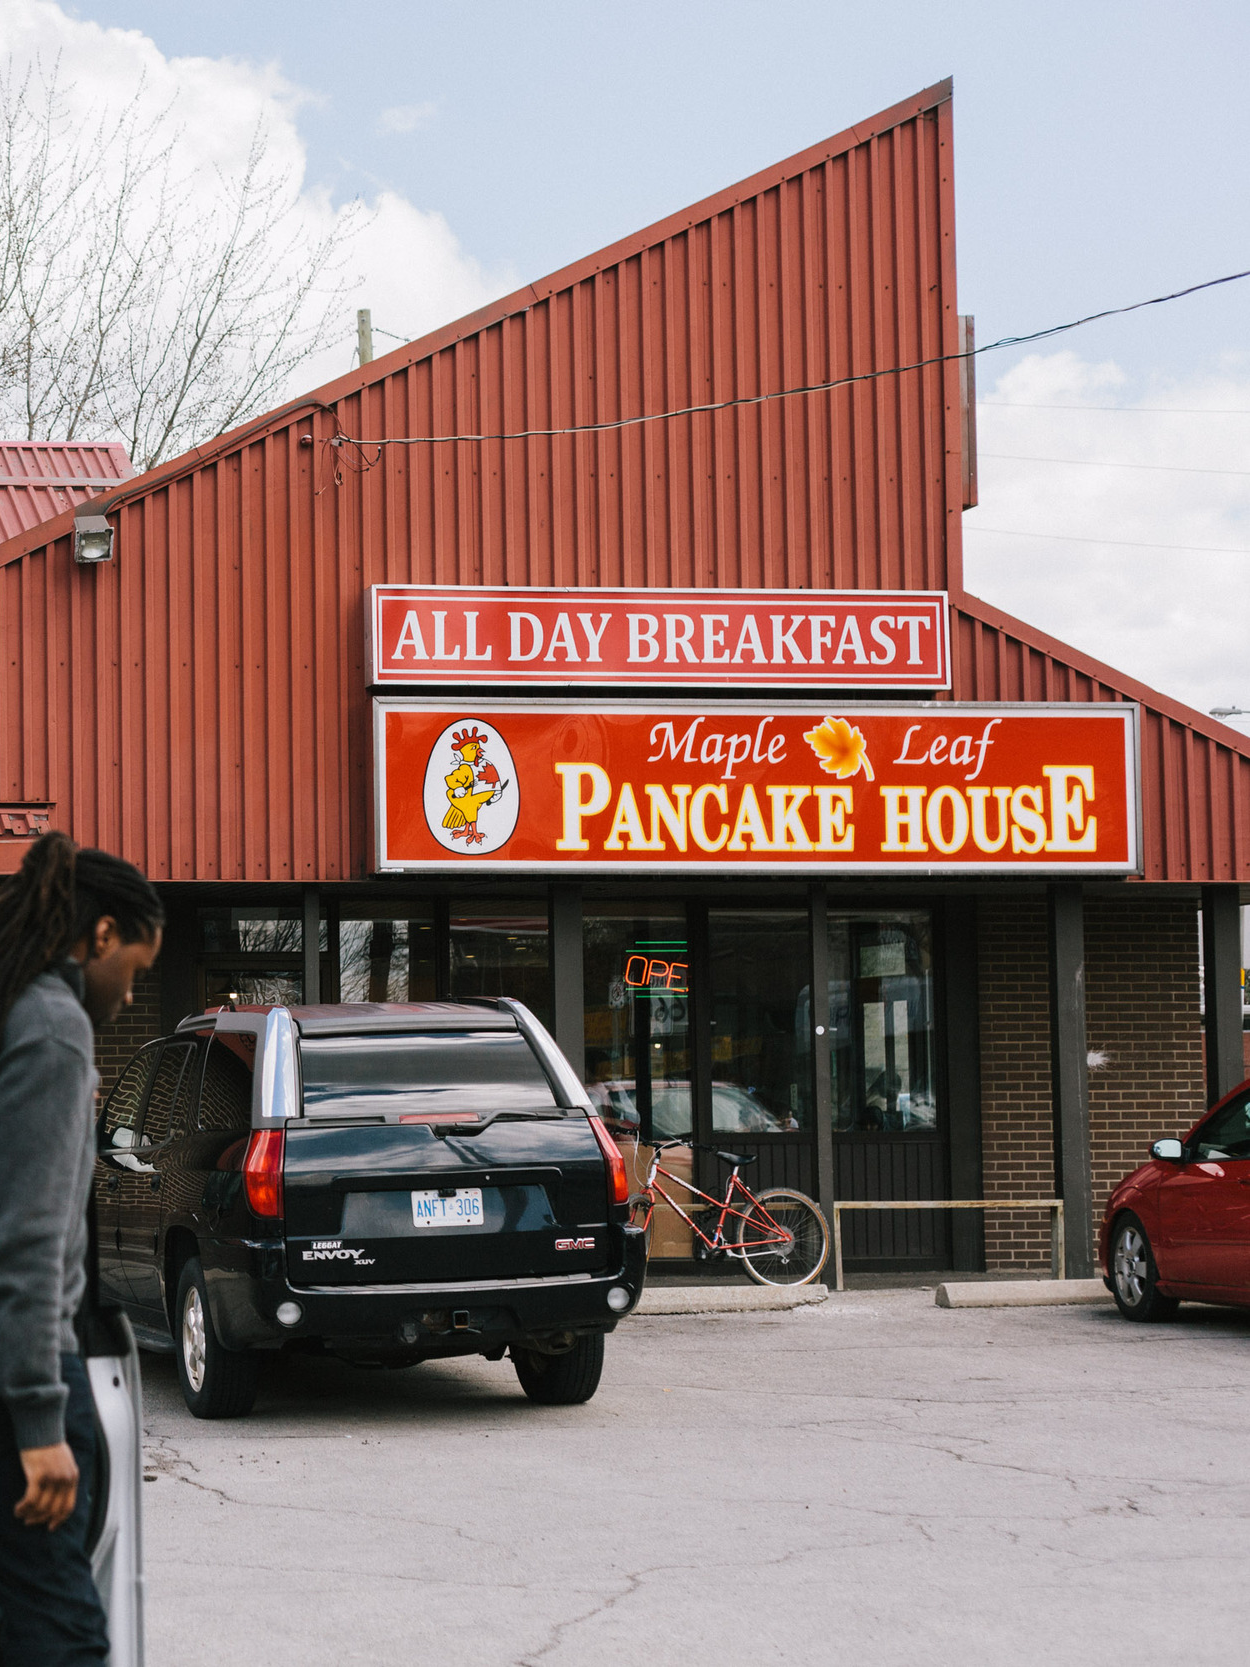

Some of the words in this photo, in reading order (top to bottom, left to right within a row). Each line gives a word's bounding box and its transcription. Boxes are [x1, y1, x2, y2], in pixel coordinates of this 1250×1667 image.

[391, 610, 492, 661] ALL
[507, 612, 612, 663] DAY
[626, 613, 931, 666] BREAKFAST
[647, 716, 787, 780] Maple
[892, 718, 1002, 781] Leaf
[555, 761, 854, 852] PANCAKE
[879, 765, 1097, 854] HOUSE
[625, 955, 689, 993] OPE
[417, 1199, 447, 1218] ANFT
[456, 1198, 480, 1216] 306
[302, 1248, 366, 1261] ENVOY
[555, 1237, 596, 1251] GMC
[354, 1258, 376, 1266] XUV
